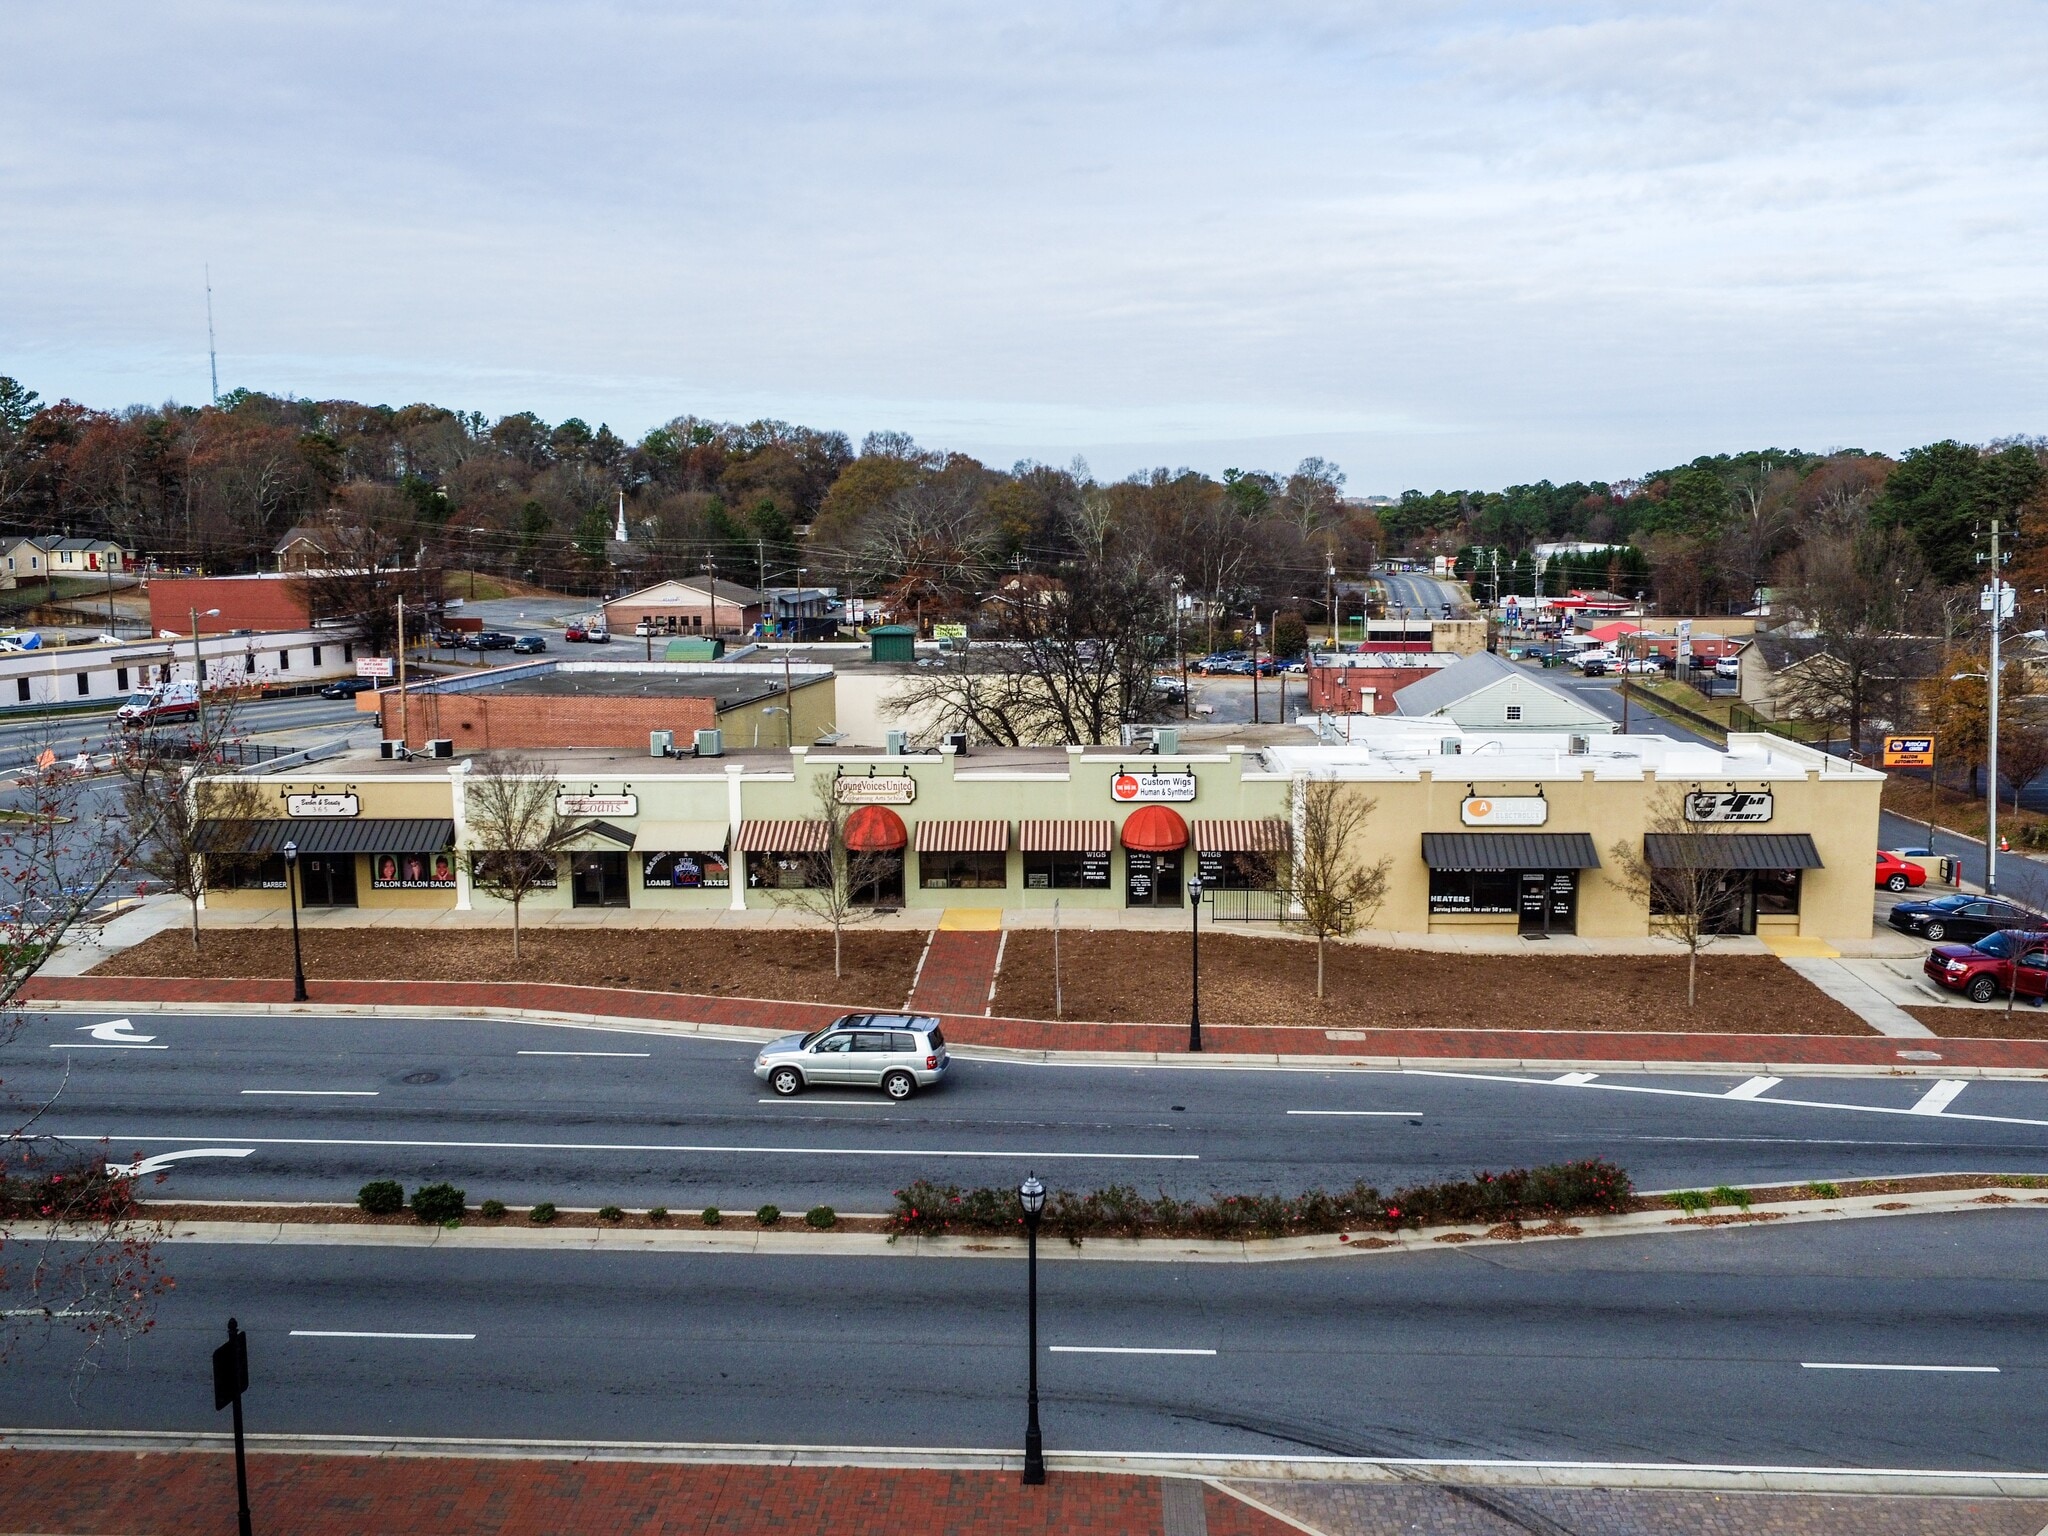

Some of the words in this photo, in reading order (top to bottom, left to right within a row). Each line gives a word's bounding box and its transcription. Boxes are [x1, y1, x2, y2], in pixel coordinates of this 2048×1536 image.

[1141, 777, 1171, 786] Custom
[1172, 777, 1192, 788] Wigs
[1140, 788, 1160, 796] Human
[1162, 788, 1166, 796] &
[1167, 788, 1194, 798] Synthetic
[301, 798, 317, 806] Barber
[324, 798, 341, 807] Beauty
[570, 798, 622, 813] Loans
[374, 880, 401, 888] SALON
[402, 880, 429, 888] SALON
[430, 880, 456, 888] SALON
[646, 879, 672, 887] LOANS
[703, 879, 729, 887] TAXES
[1430, 895, 1471, 903] HEATERS
